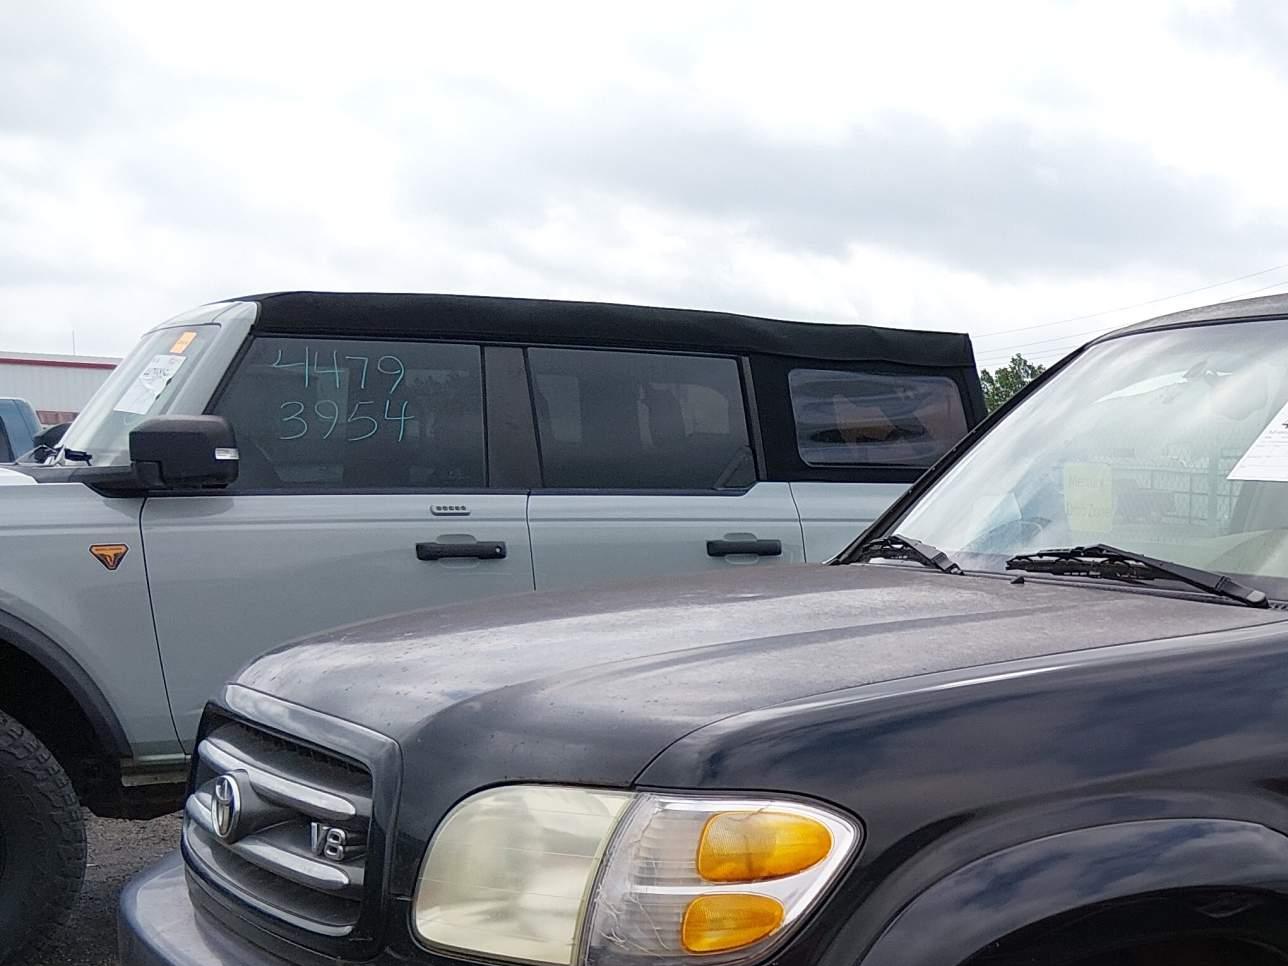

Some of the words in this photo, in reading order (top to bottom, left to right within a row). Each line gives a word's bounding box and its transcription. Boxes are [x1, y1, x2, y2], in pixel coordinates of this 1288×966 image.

[272, 346, 405, 394] 4479
[279, 400, 415, 442] 3954
[311, 821, 346, 860] V8
